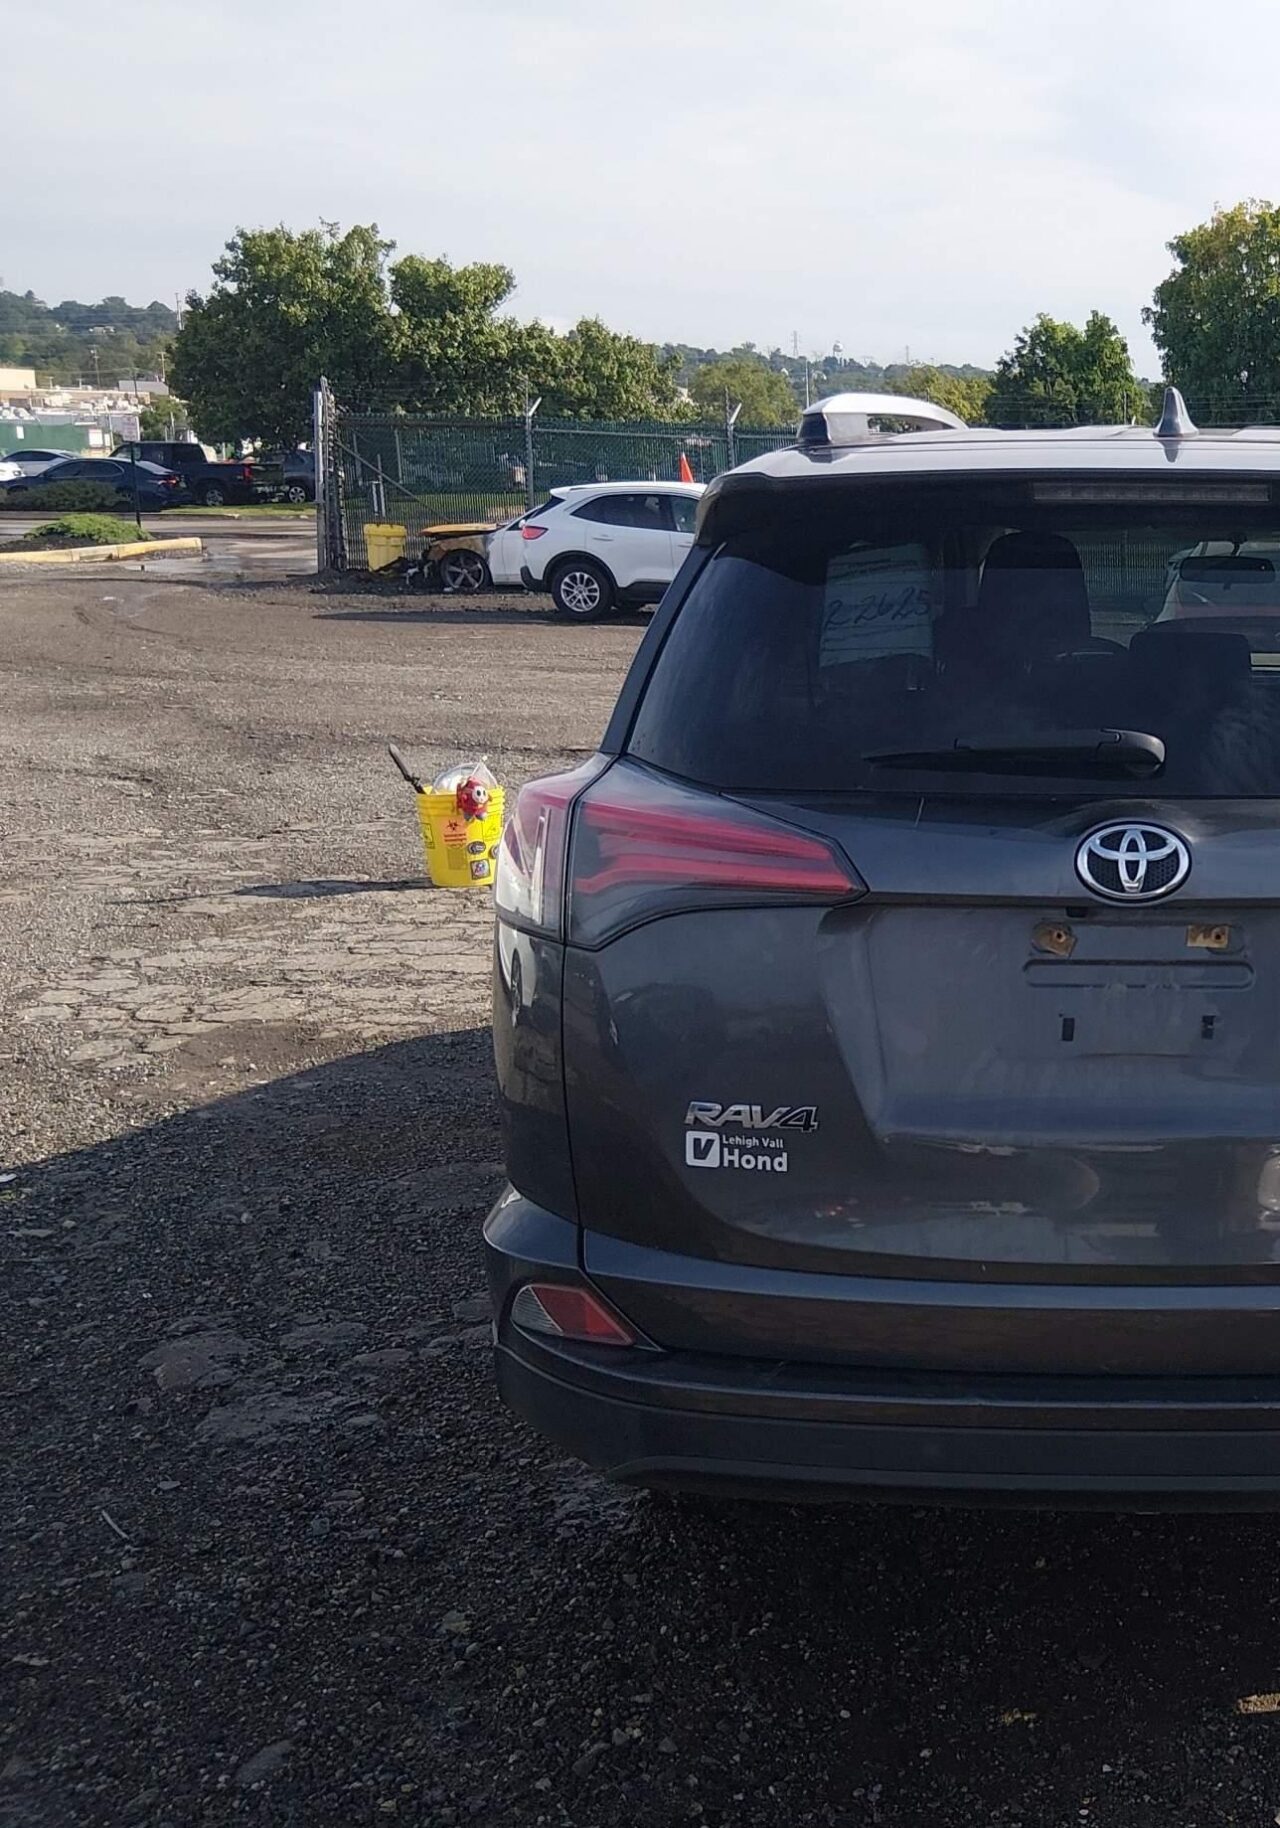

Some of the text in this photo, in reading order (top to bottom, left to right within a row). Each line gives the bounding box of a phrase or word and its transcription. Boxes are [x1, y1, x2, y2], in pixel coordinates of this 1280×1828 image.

[685, 1101, 818, 1133] RAV4
[722, 1134, 784, 1149] Lehigh Vall
[723, 1148, 788, 1172] Hond
